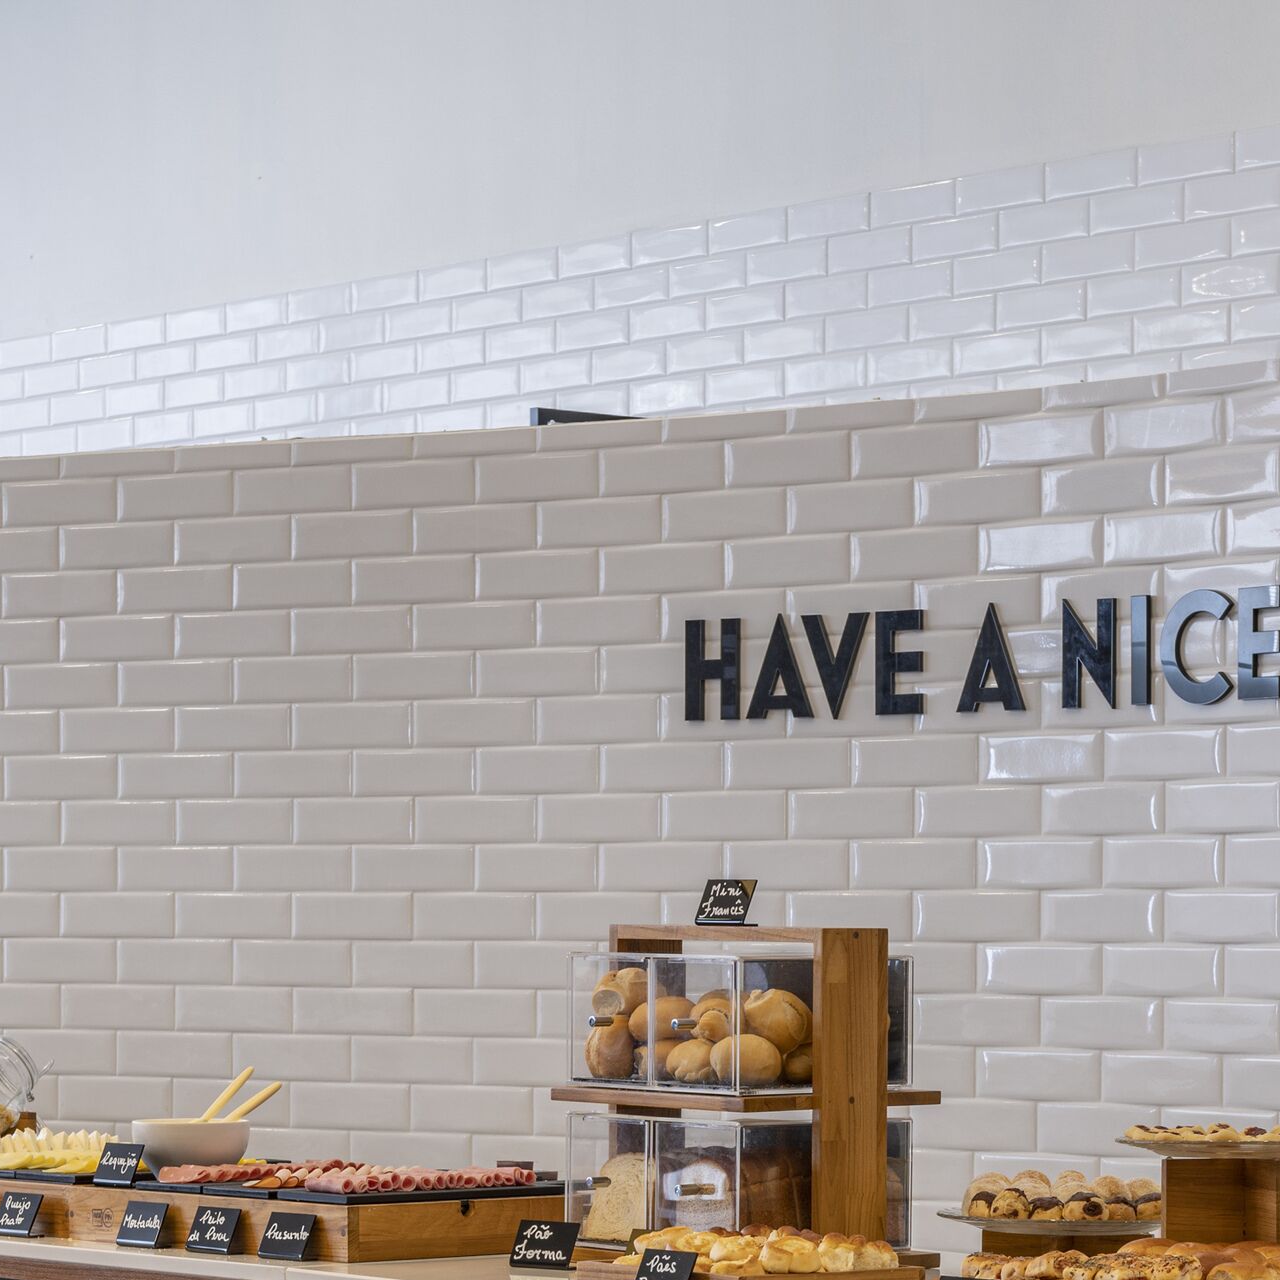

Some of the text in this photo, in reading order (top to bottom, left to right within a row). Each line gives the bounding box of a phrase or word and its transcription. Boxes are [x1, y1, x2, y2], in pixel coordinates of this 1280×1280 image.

[684, 608, 925, 722] HAVE
[956, 602, 1027, 713] A
[710, 882, 743, 897] Mini
[699, 896, 745, 918] Francês
[5, 1195, 31, 1215] Queijo
[199, 1209, 226, 1225] Peito
[187, 1226, 230, 1242] de Peru
[265, 1222, 310, 1241] Presunto
[523, 1224, 554, 1240] Pão
[513, 1239, 567, 1261] Forma
[645, 1254, 677, 1274] Pães
